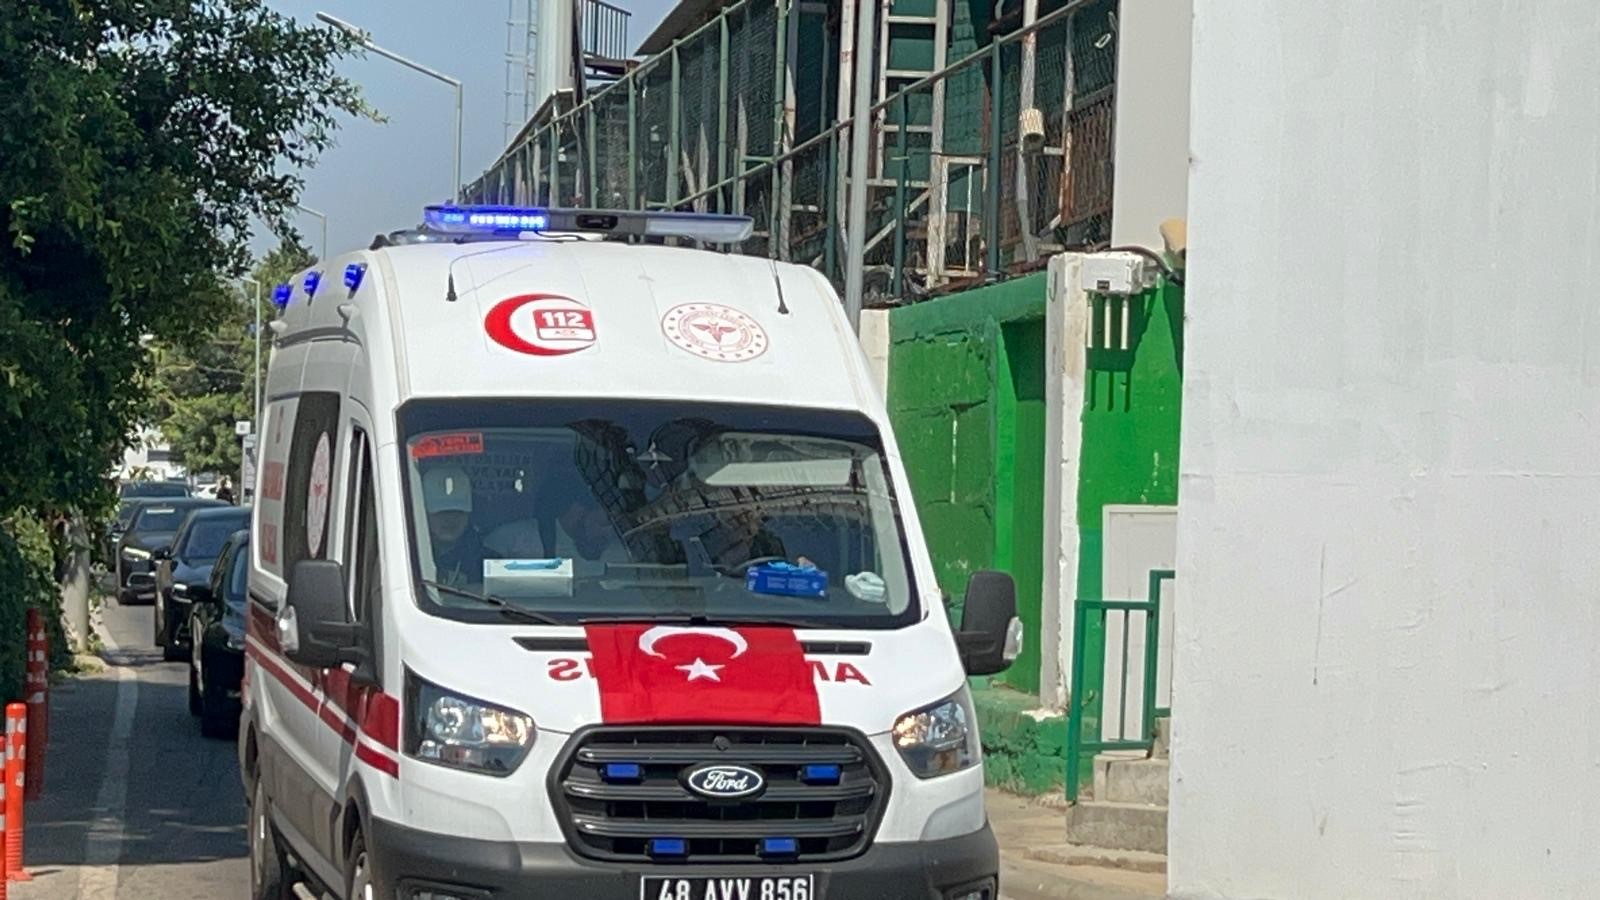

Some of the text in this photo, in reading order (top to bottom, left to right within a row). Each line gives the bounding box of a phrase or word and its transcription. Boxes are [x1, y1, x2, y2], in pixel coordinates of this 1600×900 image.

[542, 311, 587, 328] 112
[703, 770, 748, 790] Ford
[658, 879, 691, 900] 48
[760, 877, 808, 900] 856
